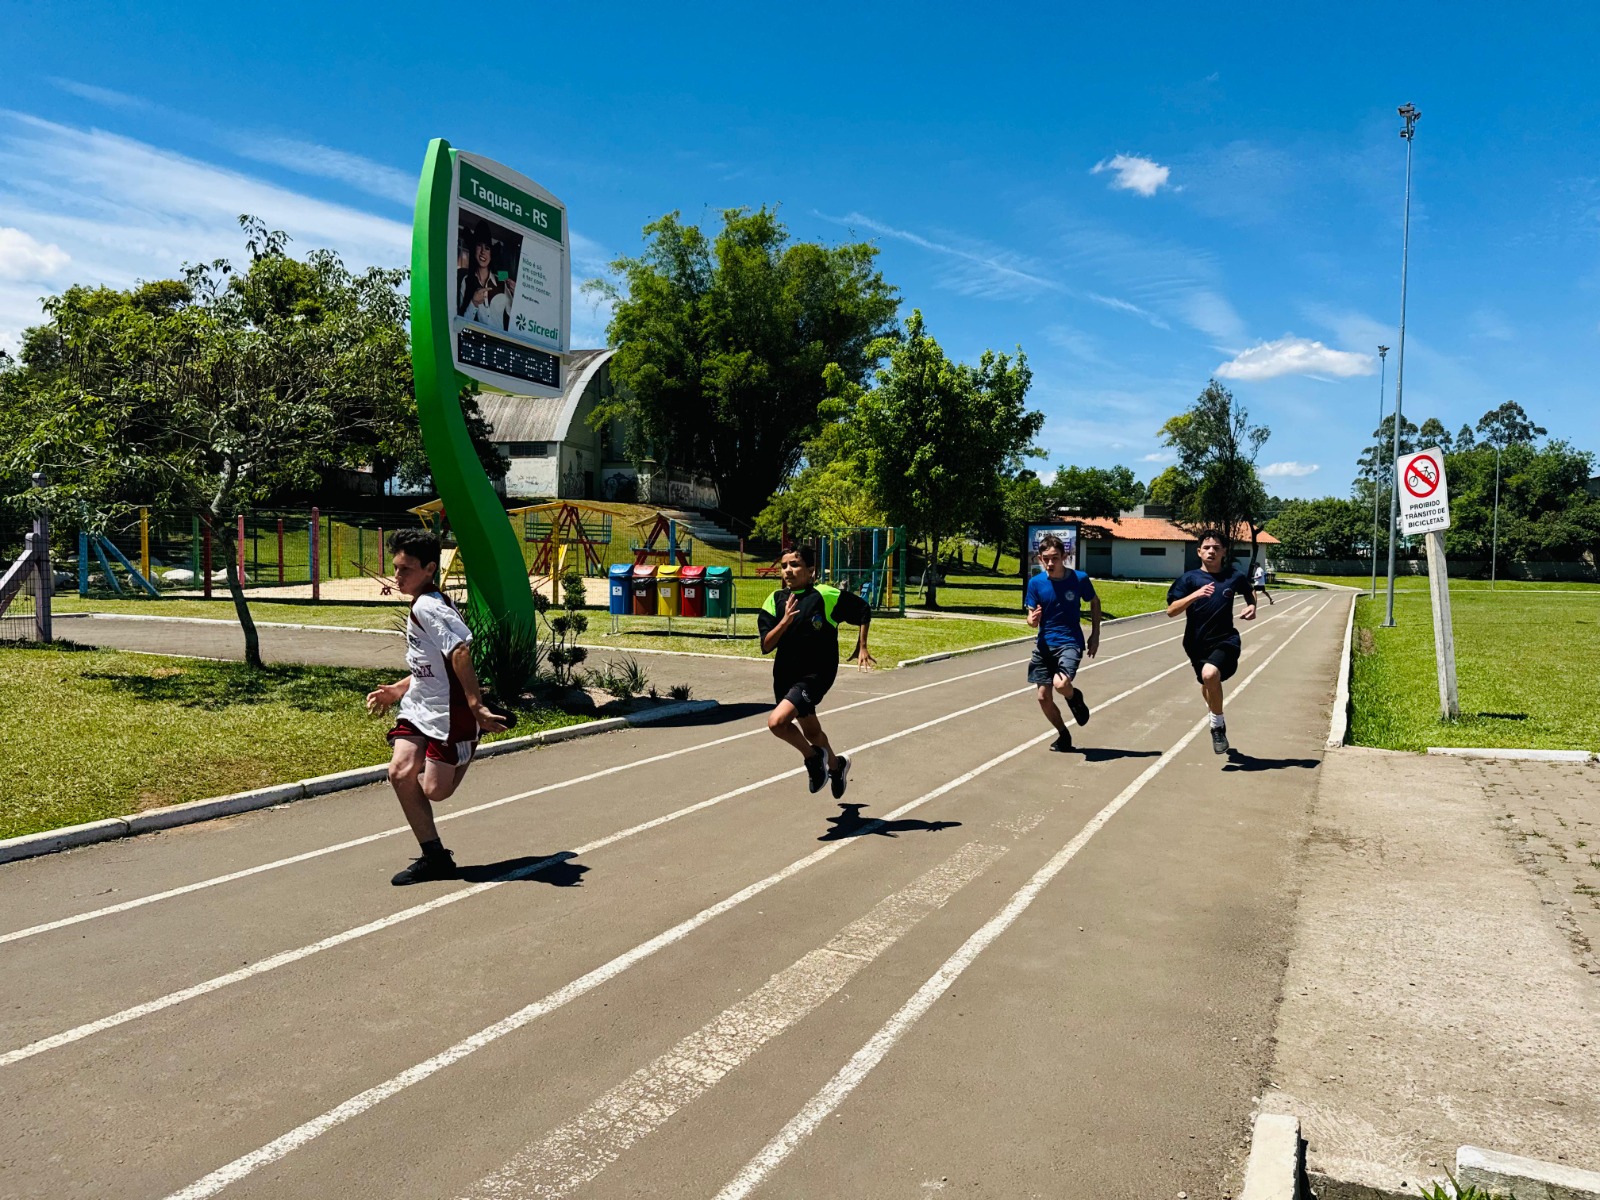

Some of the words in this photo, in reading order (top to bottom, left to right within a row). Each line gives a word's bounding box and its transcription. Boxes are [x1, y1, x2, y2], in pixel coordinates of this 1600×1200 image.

[470, 178, 522, 217] Taquara
[532, 208, 548, 229] RS
[528, 319, 558, 340] Sicredi
[1410, 500, 1440, 510] PROIBIDO
[1408, 517, 1444, 528] BICICLETAS
